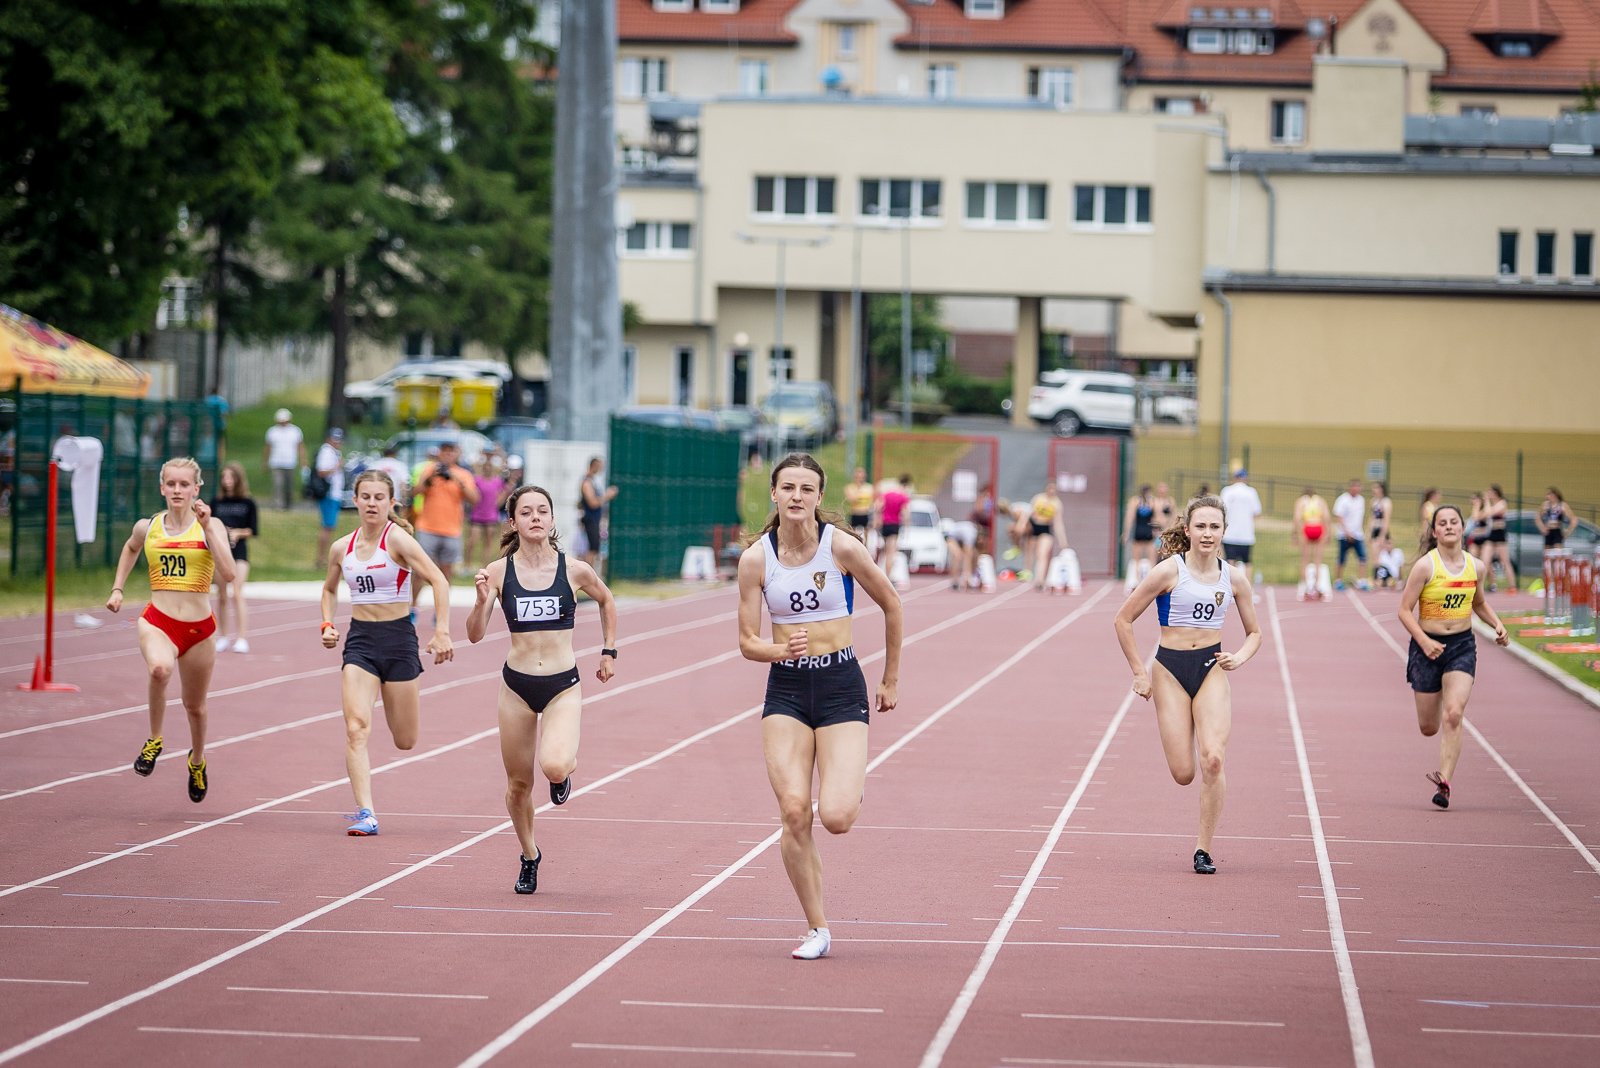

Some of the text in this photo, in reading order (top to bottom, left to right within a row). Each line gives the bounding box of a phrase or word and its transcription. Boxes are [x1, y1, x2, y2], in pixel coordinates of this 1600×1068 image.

[160, 555, 186, 577] 329
[356, 575, 376, 593] 30
[519, 598, 557, 618] 753
[789, 589, 820, 612] 83
[1192, 602, 1215, 620] 89
[797, 653, 832, 669] PRO
